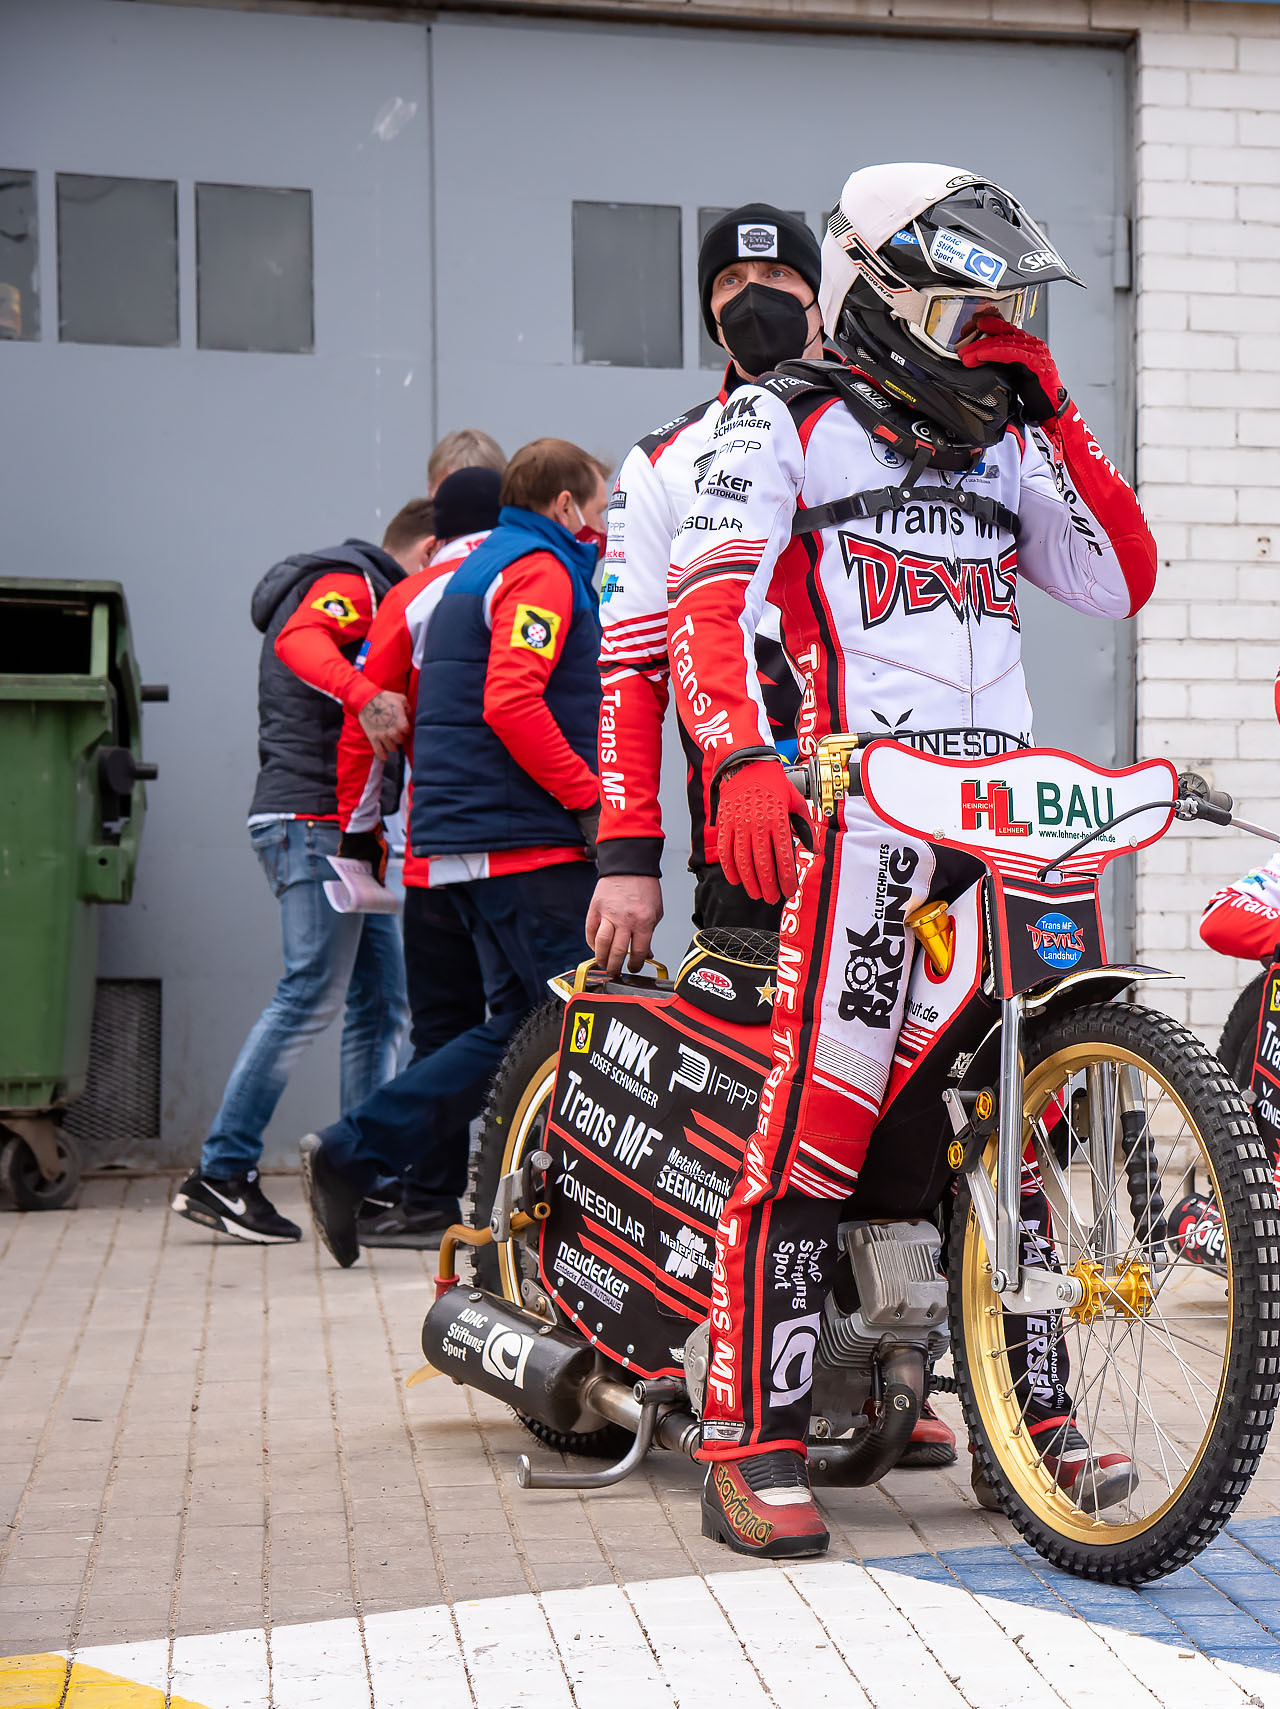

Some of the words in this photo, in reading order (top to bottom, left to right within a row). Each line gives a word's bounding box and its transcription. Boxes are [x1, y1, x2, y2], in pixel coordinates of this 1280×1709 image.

[933, 248, 954, 264] Sport
[936, 240, 966, 260] Stiftung
[940, 233, 962, 247] ADAC
[857, 265, 895, 300] PROGRIP
[670, 614, 712, 717] Trans
[600, 689, 622, 764] Trans
[601, 771, 626, 811] MF
[962, 802, 994, 811] HEINRICH
[1036, 781, 1115, 830] BAU
[874, 843, 890, 920] CLUTCHPLATES
[1025, 923, 1085, 953] DEVILS
[1041, 921, 1061, 931] Trans
[1062, 922, 1073, 931] MF
[1043, 951, 1078, 962] Landshut
[777, 947, 803, 1012] MF
[602, 1017, 659, 1084] WWK
[589, 1051, 615, 1079] JOSEF
[610, 1065, 660, 1109] SCHWAIGER
[714, 1072, 758, 1111] PIPP
[560, 1070, 617, 1148] Trans
[613, 1114, 663, 1170] MF
[563, 1174, 646, 1247] ONESOLAR
[557, 1241, 630, 1299] neudecker
[660, 1231, 690, 1256] Maler
[689, 1248, 715, 1272] Eiba
[774, 1240, 795, 1290] Sport
[447, 1322, 485, 1353] Stiftung
[457, 1308, 489, 1329] ADAC
[441, 1337, 467, 1361] Sport
[710, 1345, 735, 1409] MF
